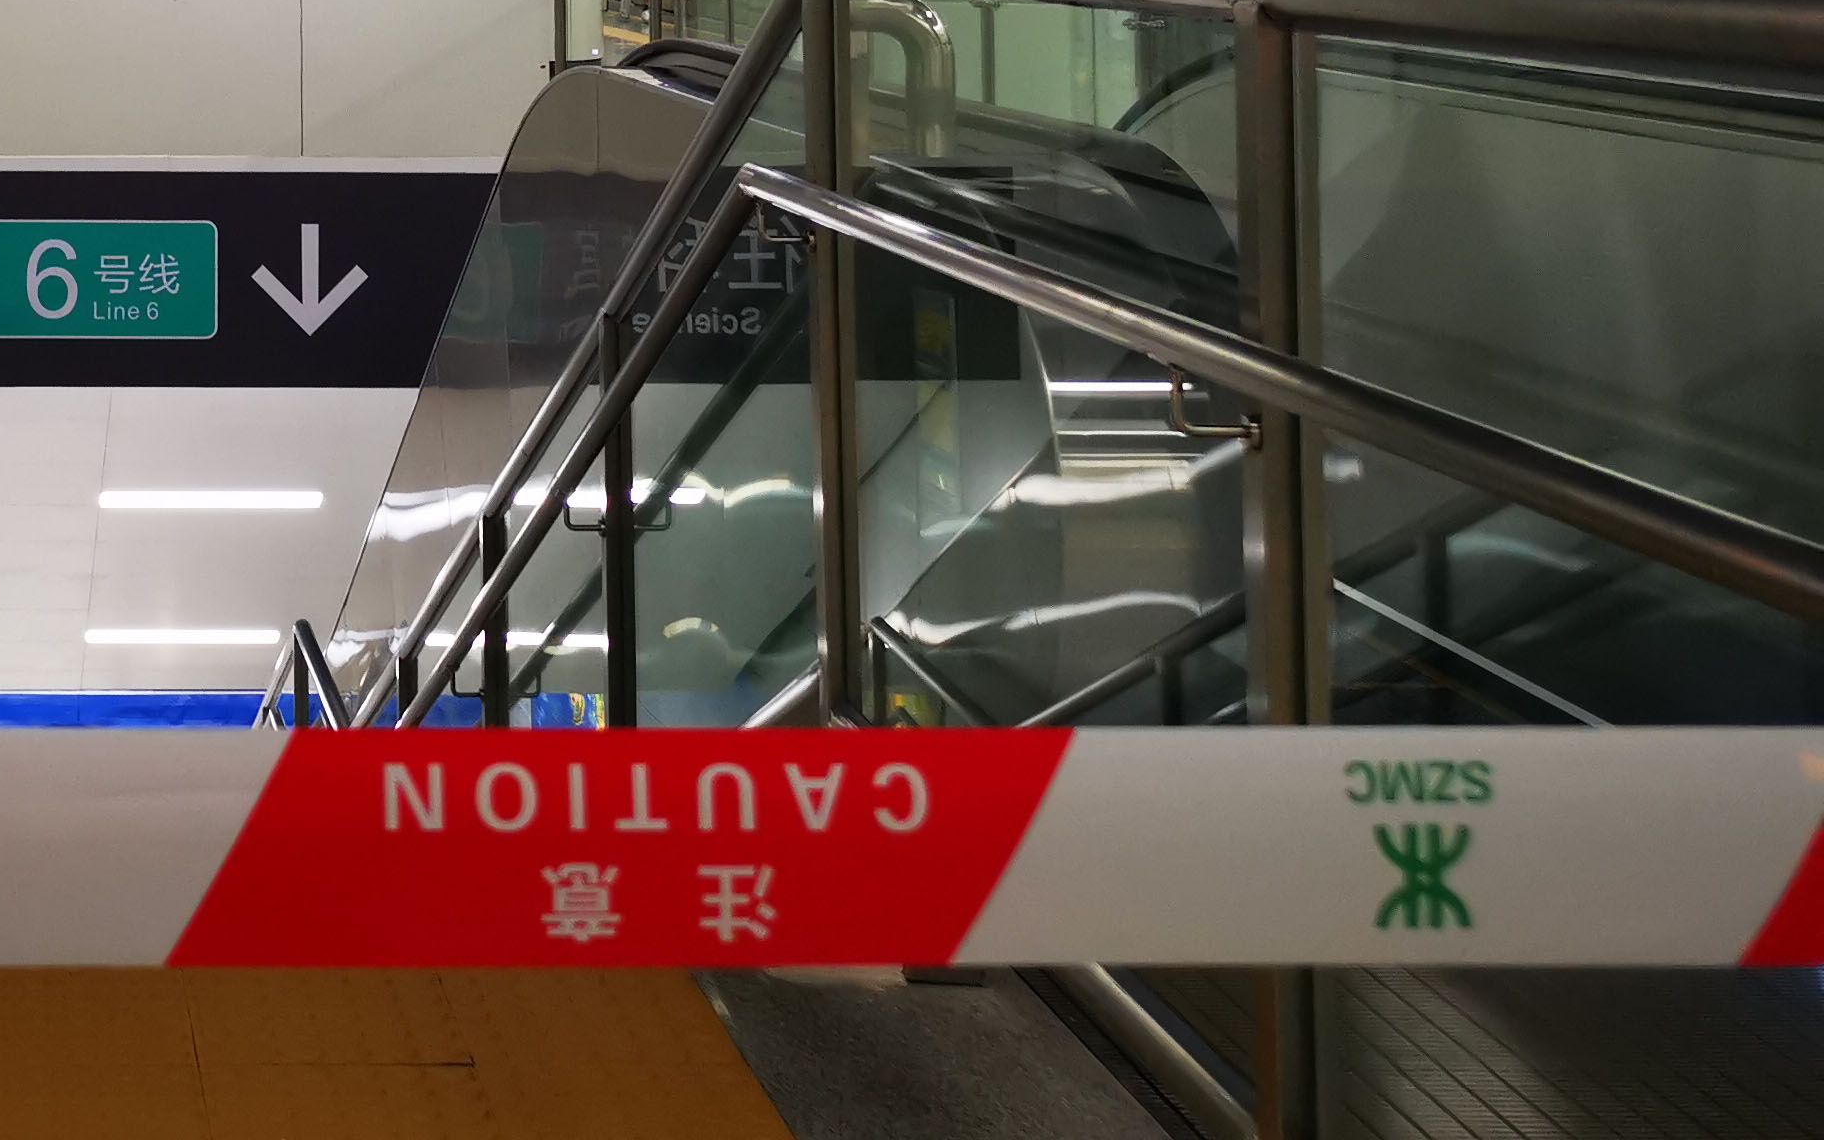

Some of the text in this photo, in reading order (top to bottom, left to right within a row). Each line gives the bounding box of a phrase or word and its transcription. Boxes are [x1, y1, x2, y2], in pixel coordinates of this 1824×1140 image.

[25, 238, 181, 321] 6 号线
[93, 301, 160, 320] Line 6
[386, 765, 928, 832] CAUTION
[1344, 759, 1494, 805] SZMC
[545, 865, 775, 942] 注意
